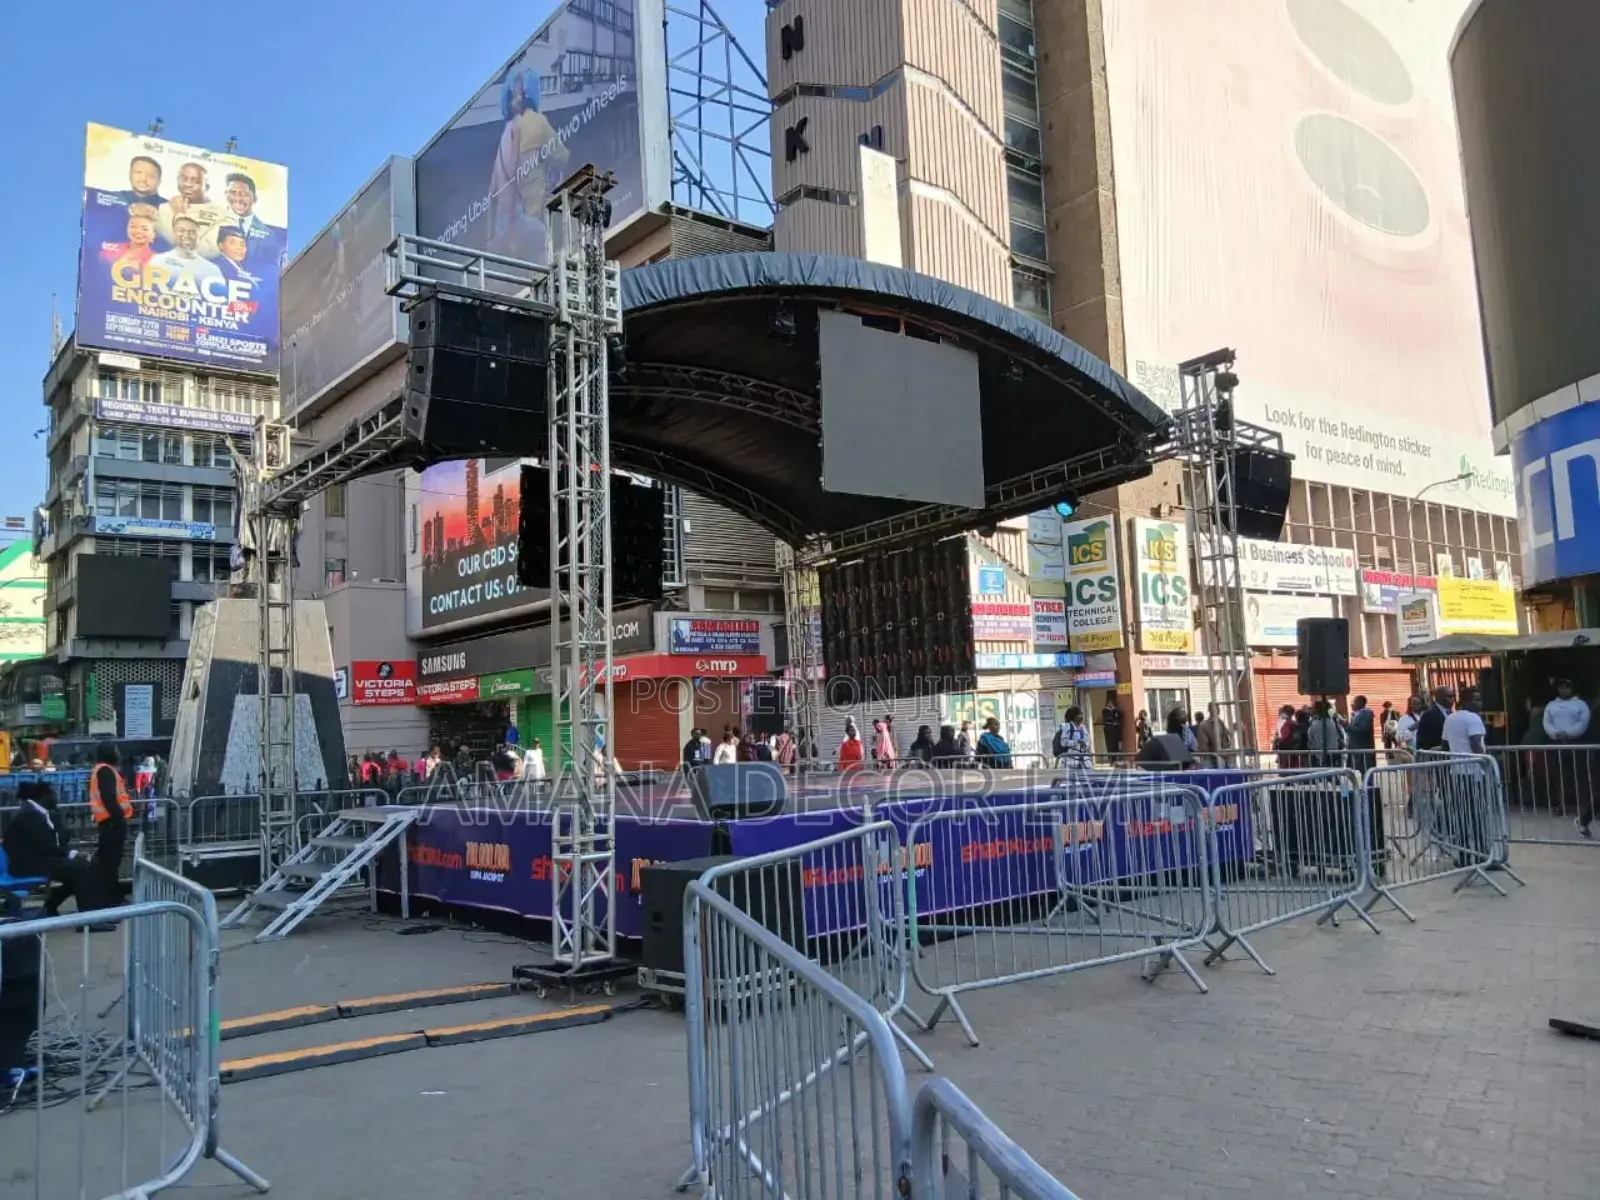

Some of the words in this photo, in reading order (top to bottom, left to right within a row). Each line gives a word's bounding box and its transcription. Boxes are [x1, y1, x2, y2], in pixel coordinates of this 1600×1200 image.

[781, 14, 803, 61] N
[468, 192, 493, 222] Uber
[515, 152, 539, 181] now
[539, 142, 556, 160] on
[556, 116, 581, 146] two
[582, 72, 627, 122] wheels
[786, 116, 810, 162] K
[111, 258, 252, 303] GRACE
[112, 286, 249, 324] ENCOUNTER
[138, 307, 189, 322] NAIROBI
[199, 315, 238, 331] KENYA
[102, 400, 144, 414] REGIONAL
[147, 405, 169, 415] TECH
[180, 408, 218, 421] BUSINESS
[1265, 403, 1297, 428] Look
[1299, 410, 1315, 431] for
[1319, 417, 1339, 437] the
[1341, 424, 1397, 451] Redington
[1398, 438, 1433, 460] sticker
[1306, 443, 1322, 462] for
[1326, 448, 1361, 470] peace
[1363, 455, 1375, 470] of
[1376, 460, 1407, 479] mind.
[458, 554, 481, 577] OUR
[483, 546, 506, 569] CBD
[1073, 542, 1103, 564] ICS
[1148, 541, 1174, 561] ICS
[1249, 543, 1304, 566] Business
[1307, 548, 1346, 568] School
[430, 584, 481, 614] CONTACT
[484, 578, 504, 600] US:
[1065, 575, 1117, 607] ICS
[1141, 572, 1188, 607] ICS
[1034, 601, 1063, 612] CYBER
[1068, 607, 1118, 618] TECHNICAL
[1144, 607, 1188, 619] TECHNICAL
[1073, 615, 1113, 628] COLLEGE
[421, 651, 466, 676] SAMSUNG
[710, 659, 738, 674] mrp
[355, 679, 414, 688] VICTORIA
[364, 689, 405, 697] STEPS
[416, 682, 449, 696] VICTORIA
[450, 679, 476, 691] STEPS
